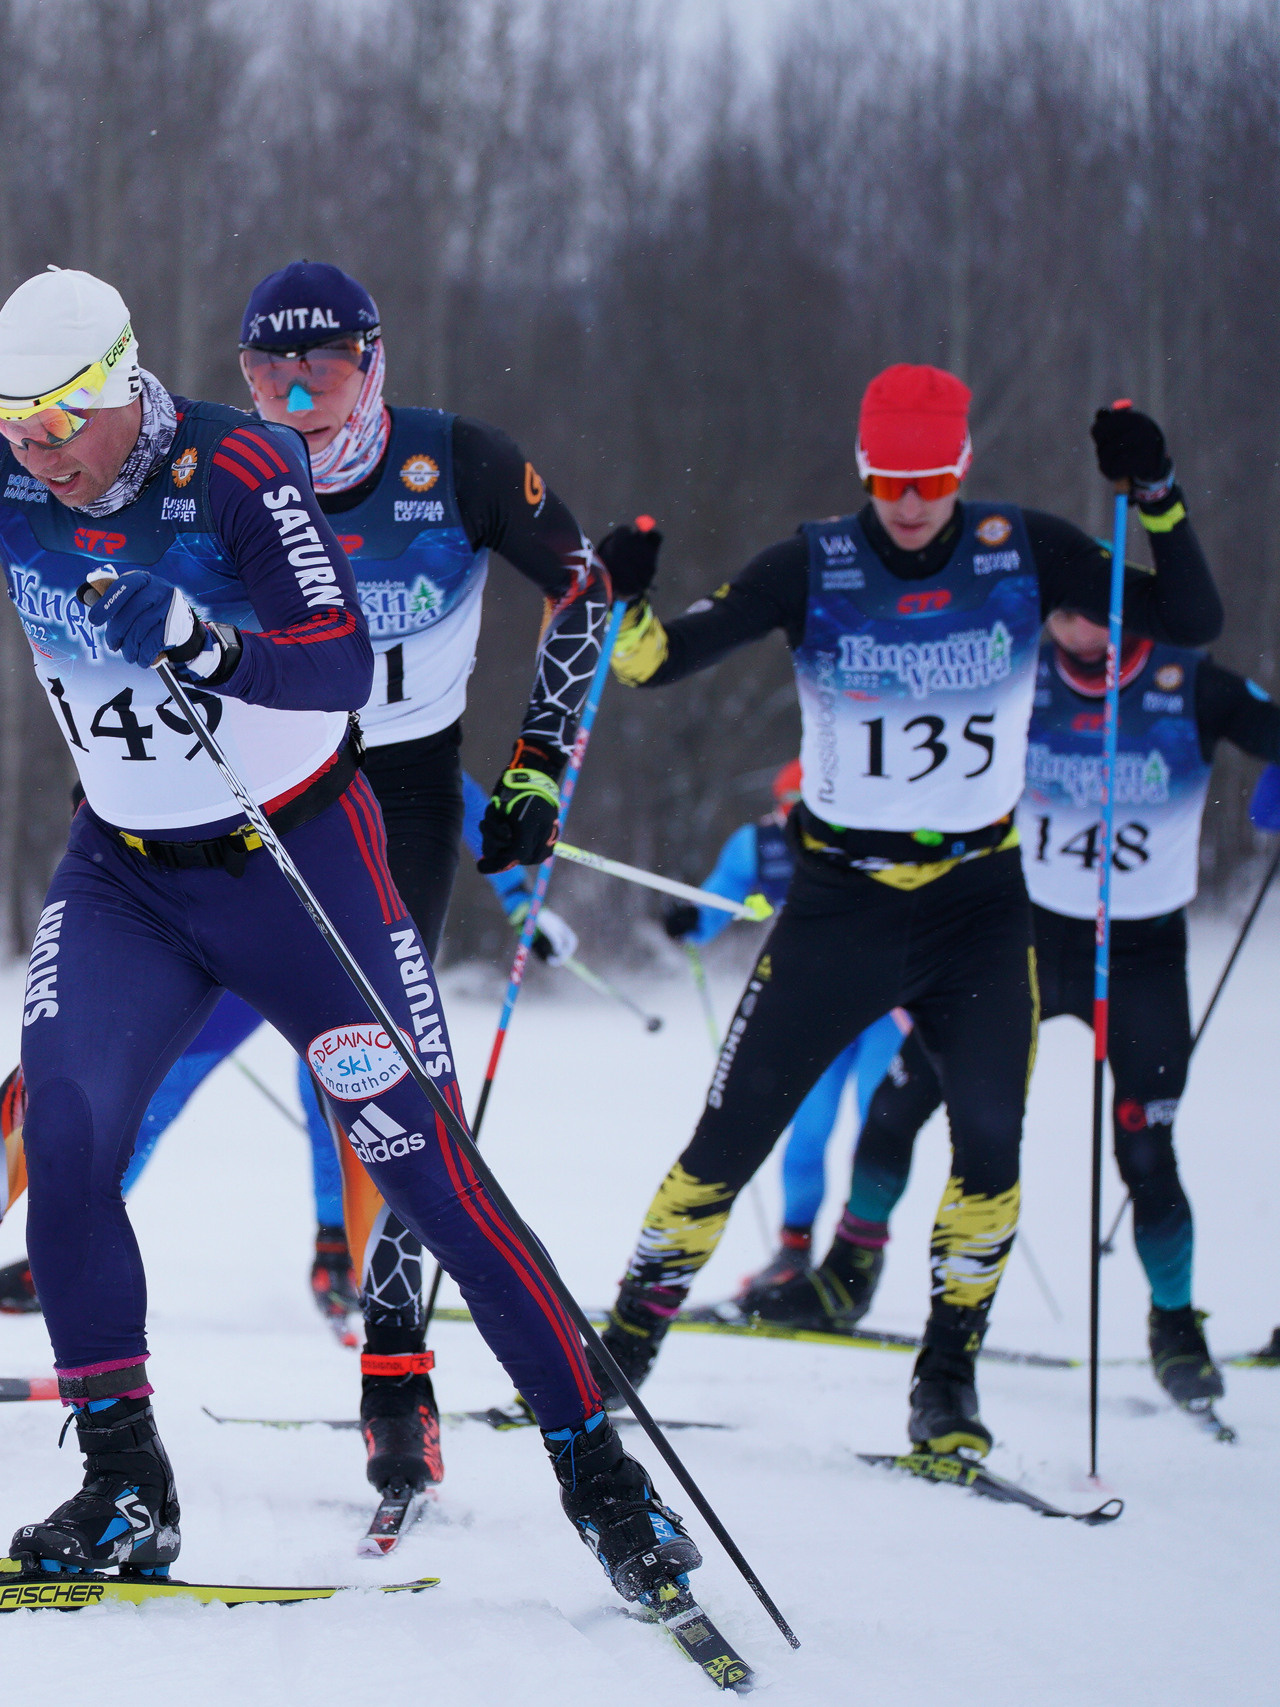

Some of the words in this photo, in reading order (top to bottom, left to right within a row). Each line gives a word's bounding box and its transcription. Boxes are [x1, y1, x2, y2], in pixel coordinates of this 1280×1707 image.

[268, 307, 340, 333] VITAL
[263, 485, 345, 608] SATURN
[47, 677, 223, 761] 149
[858, 708, 999, 783] 135
[1033, 815, 1150, 872] 148
[23, 900, 67, 1027] SATURN
[389, 928, 453, 1078] SATURN
[314, 1031, 392, 1064] DEMINO
[325, 1063, 401, 1094] marathon
[0, 1584, 105, 1606] FISCHER
